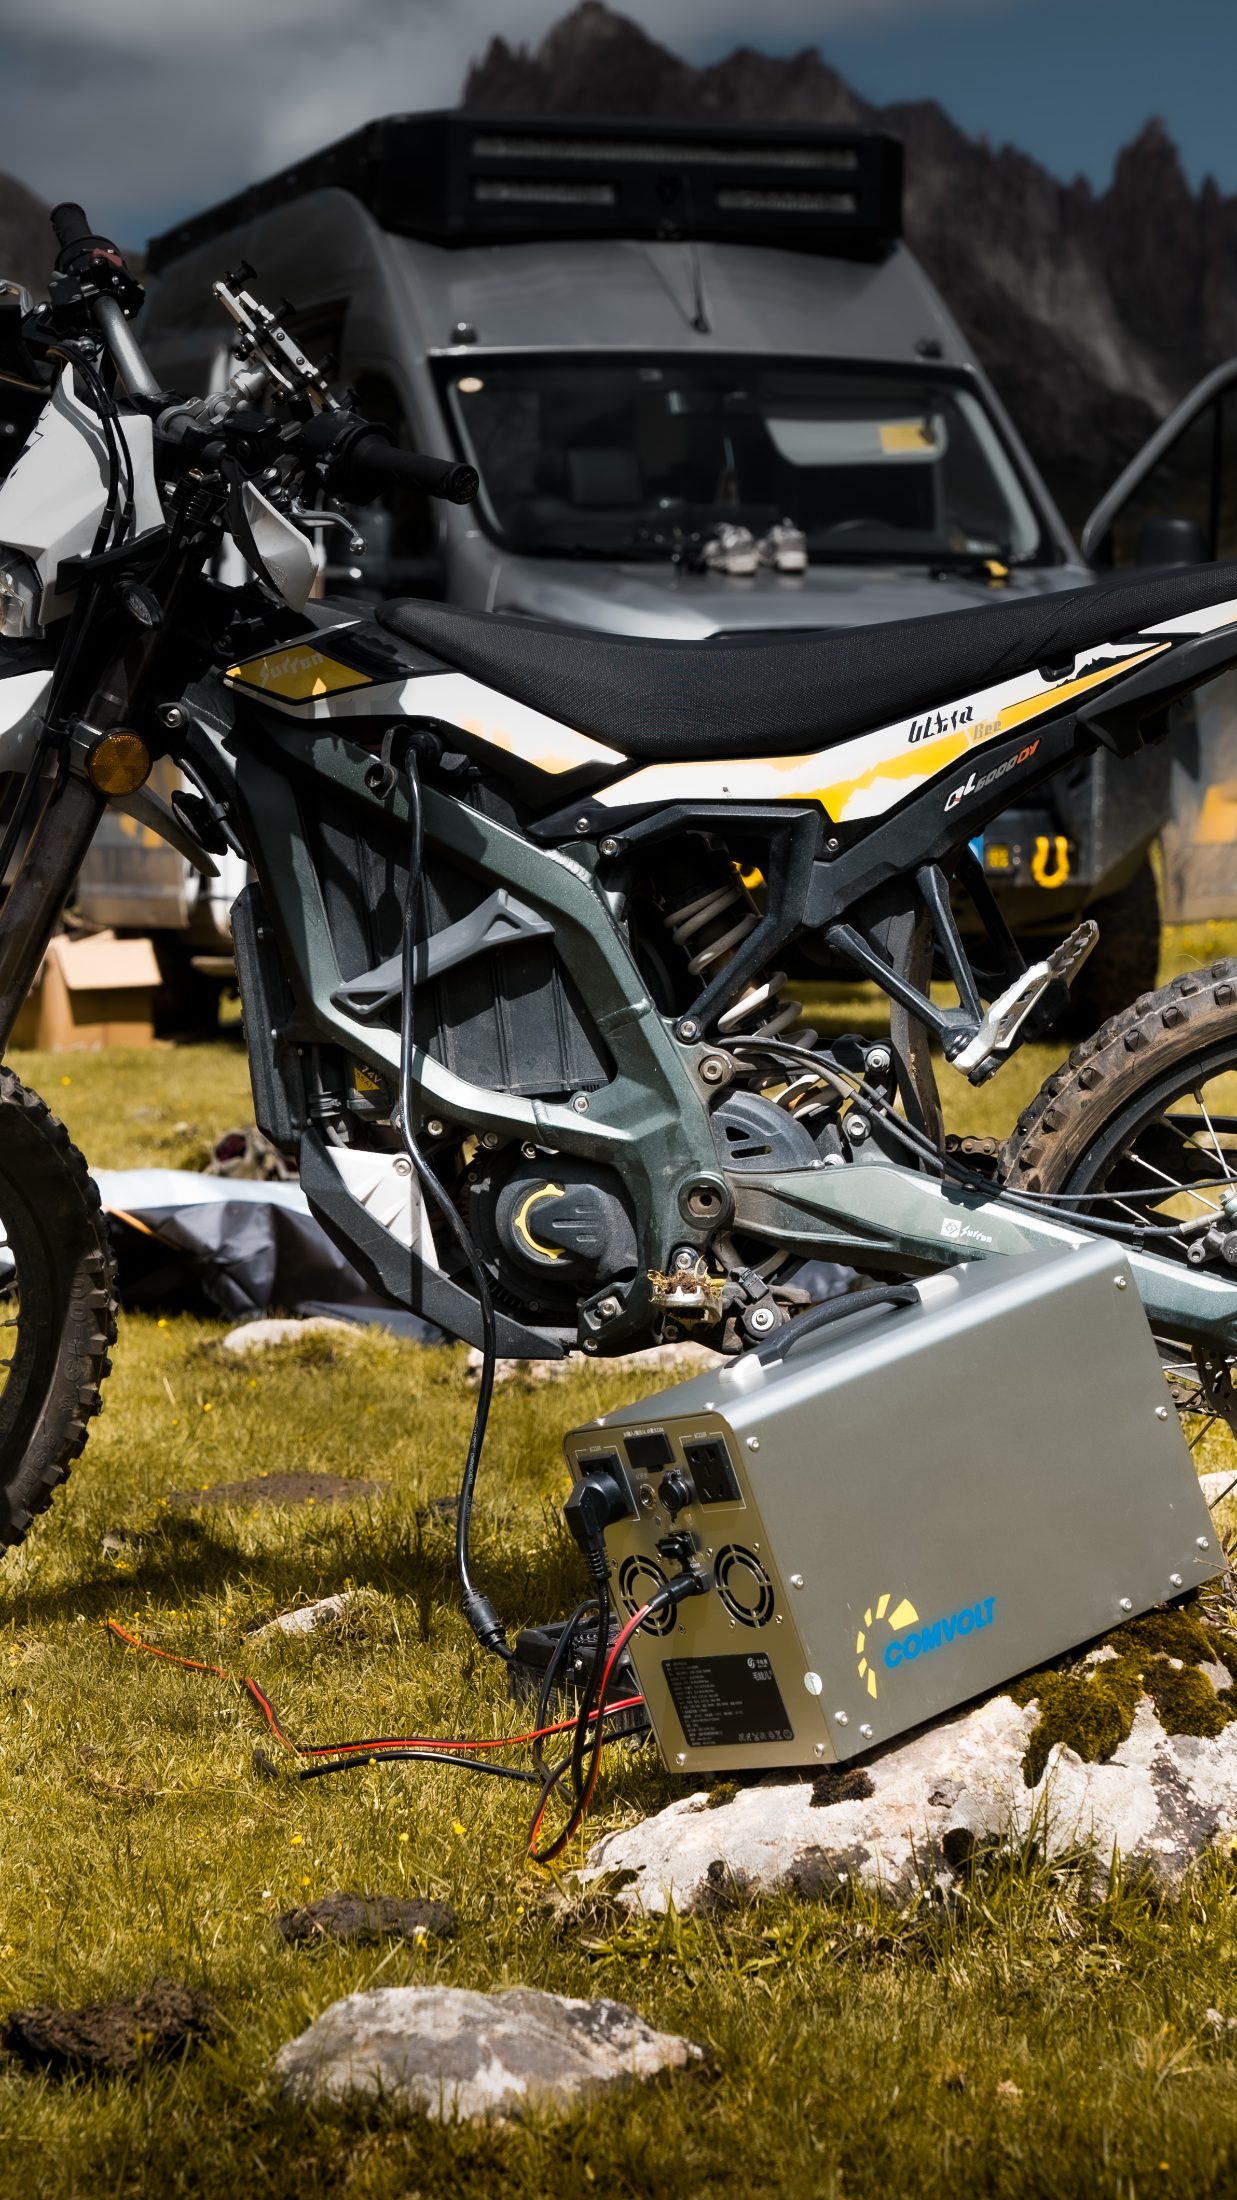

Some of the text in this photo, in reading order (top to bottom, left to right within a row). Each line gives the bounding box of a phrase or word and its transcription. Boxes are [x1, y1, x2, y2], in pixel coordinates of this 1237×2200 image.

[259, 653, 325, 688] Surron
[907, 705, 974, 743] Ultra
[973, 720, 1002, 741] Bee
[883, 1596, 996, 1669] COMVOLT
